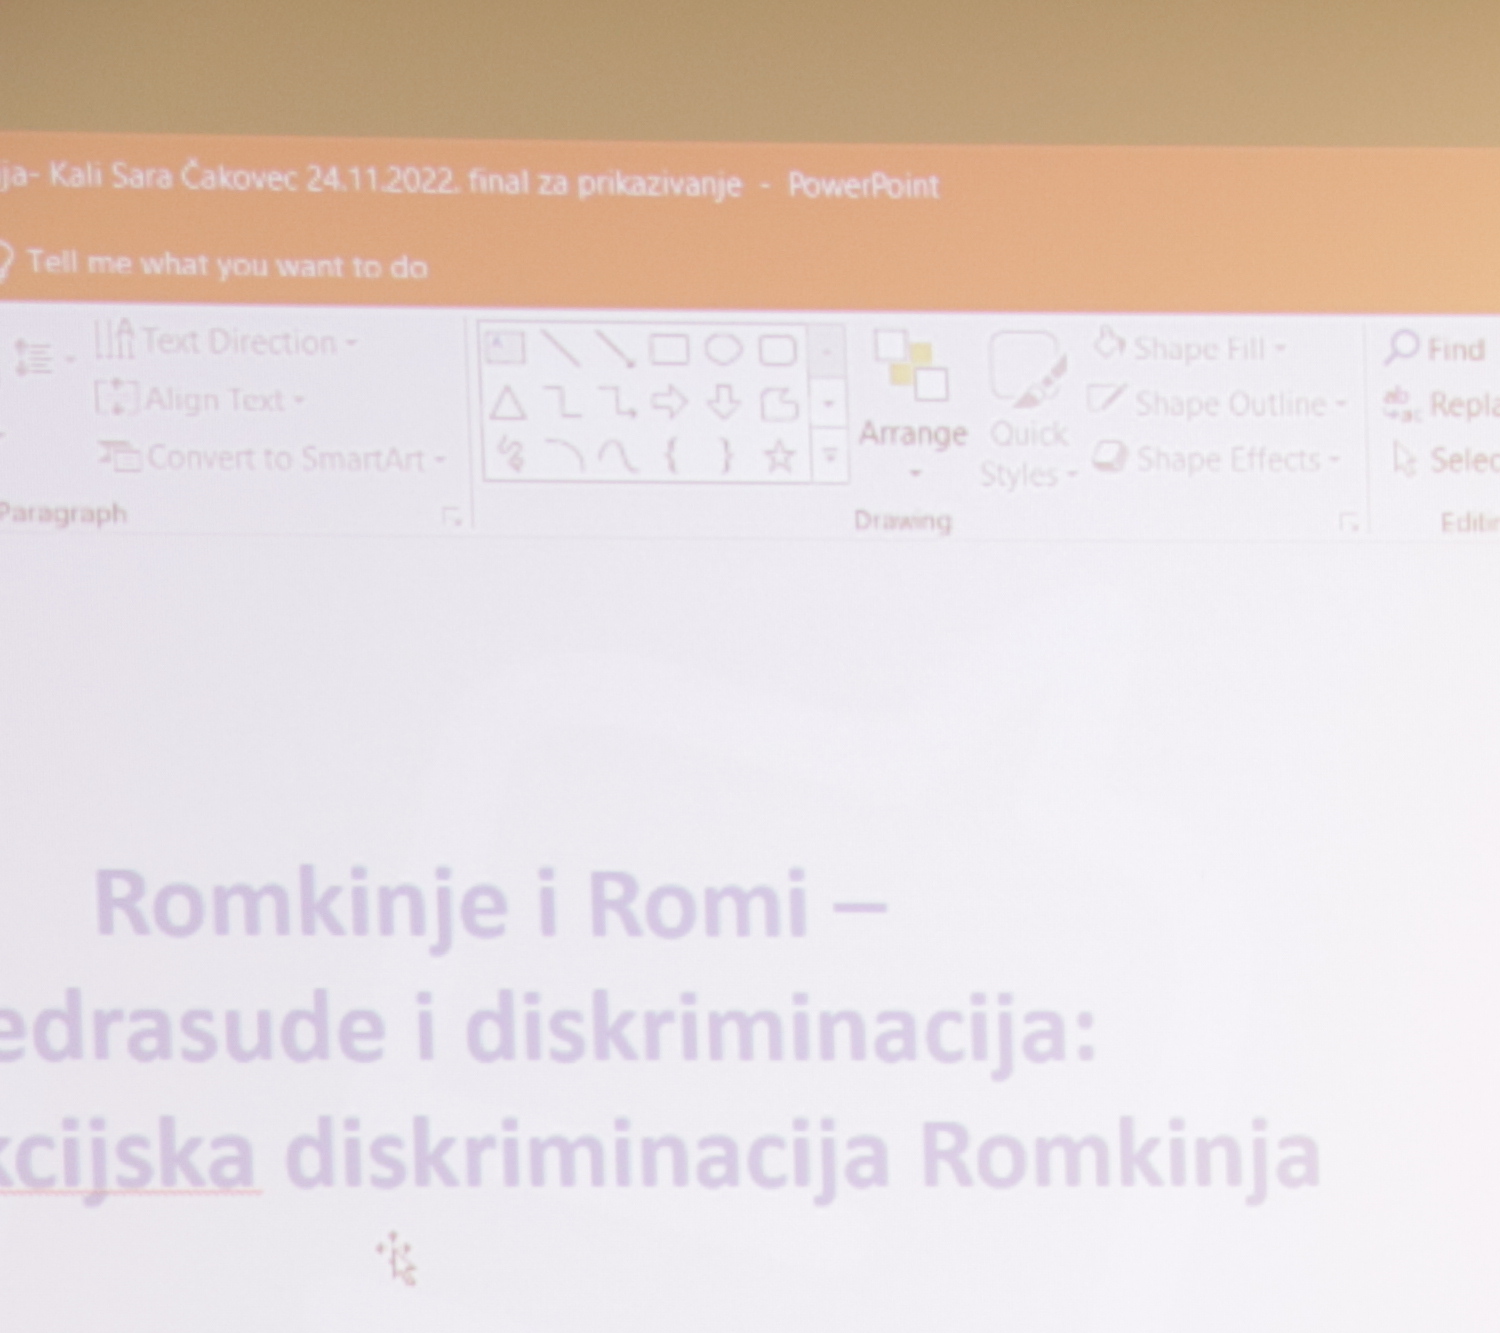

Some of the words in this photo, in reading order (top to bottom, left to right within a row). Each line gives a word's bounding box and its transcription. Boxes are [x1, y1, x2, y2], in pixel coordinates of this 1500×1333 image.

[51, 163, 101, 187] Kali
[113, 162, 172, 188] Sara
[181, 159, 295, 190] Čakovec
[469, 168, 528, 193] final
[540, 175, 568, 194] za
[579, 172, 742, 202] prikazivanje
[790, 172, 938, 198] PowerPoint
[28, 249, 77, 271] Tell
[88, 256, 132, 273] me
[141, 252, 208, 274] what
[217, 258, 268, 281] you
[277, 258, 343, 276] want
[353, 258, 381, 277] to
[391, 256, 427, 278] do
[142, 327, 199, 353] Text
[209, 327, 336, 355] Direction
[1135, 336, 1215, 365] Shape
[1228, 337, 1264, 360] Fill
[1429, 338, 1485, 361] Find
[146, 387, 219, 416] Align
[230, 387, 284, 411] Text
[1136, 390, 1220, 420] Shape
[1229, 390, 1326, 417] Outline
[859, 420, 968, 452] Arrange
[990, 420, 1068, 446] Quick
[147, 443, 254, 470] Convert
[264, 444, 293, 470] to
[302, 445, 424, 471] SmartArt
[1138, 445, 1222, 476] Shape
[1232, 443, 1320, 472] Effects
[981, 461, 1058, 492] Styles
[855, 509, 952, 535] Drawing
[96, 864, 507, 956] Romkinje
[539, 867, 556, 936] i
[591, 868, 805, 939] Romi
[417, 991, 433, 1060] i
[466, 988, 1097, 1082] diskriminacija:
[286, 1115, 887, 1205] diskriminacija
[922, 1116, 1321, 1206] Romkinja
